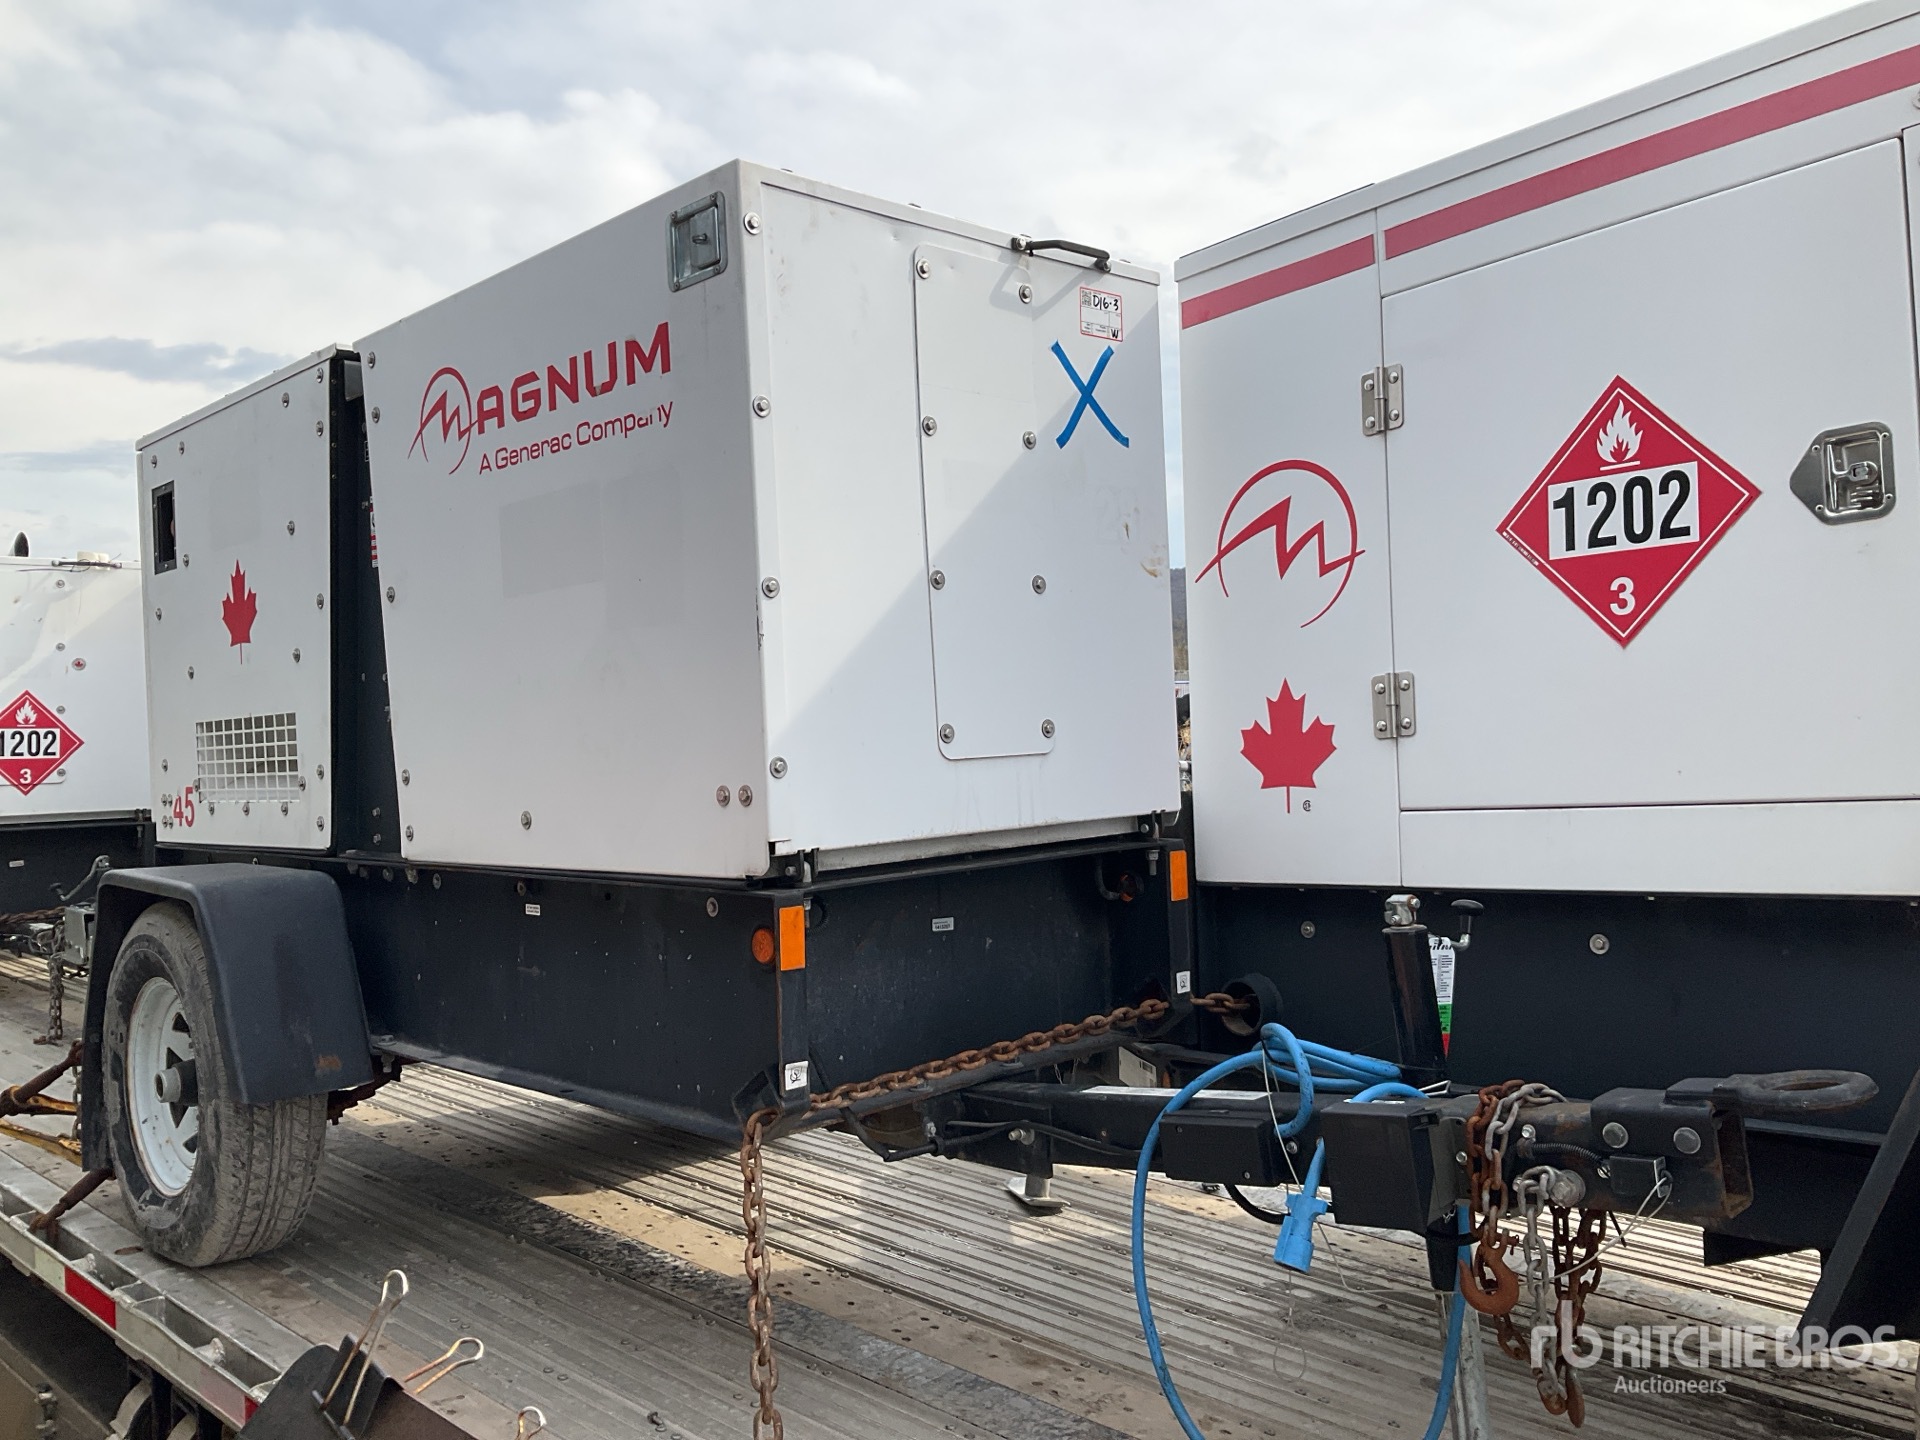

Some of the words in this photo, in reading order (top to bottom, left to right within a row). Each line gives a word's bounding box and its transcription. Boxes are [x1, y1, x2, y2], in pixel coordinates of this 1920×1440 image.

[479, 452, 493, 475] A
[495, 431, 573, 470] Generac
[1552, 469, 1692, 552] 1202
[1609, 576, 1636, 616] 3
[0, 730, 57, 757] 1202
[19, 768, 32, 785] 3
[173, 786, 195, 828] 45
